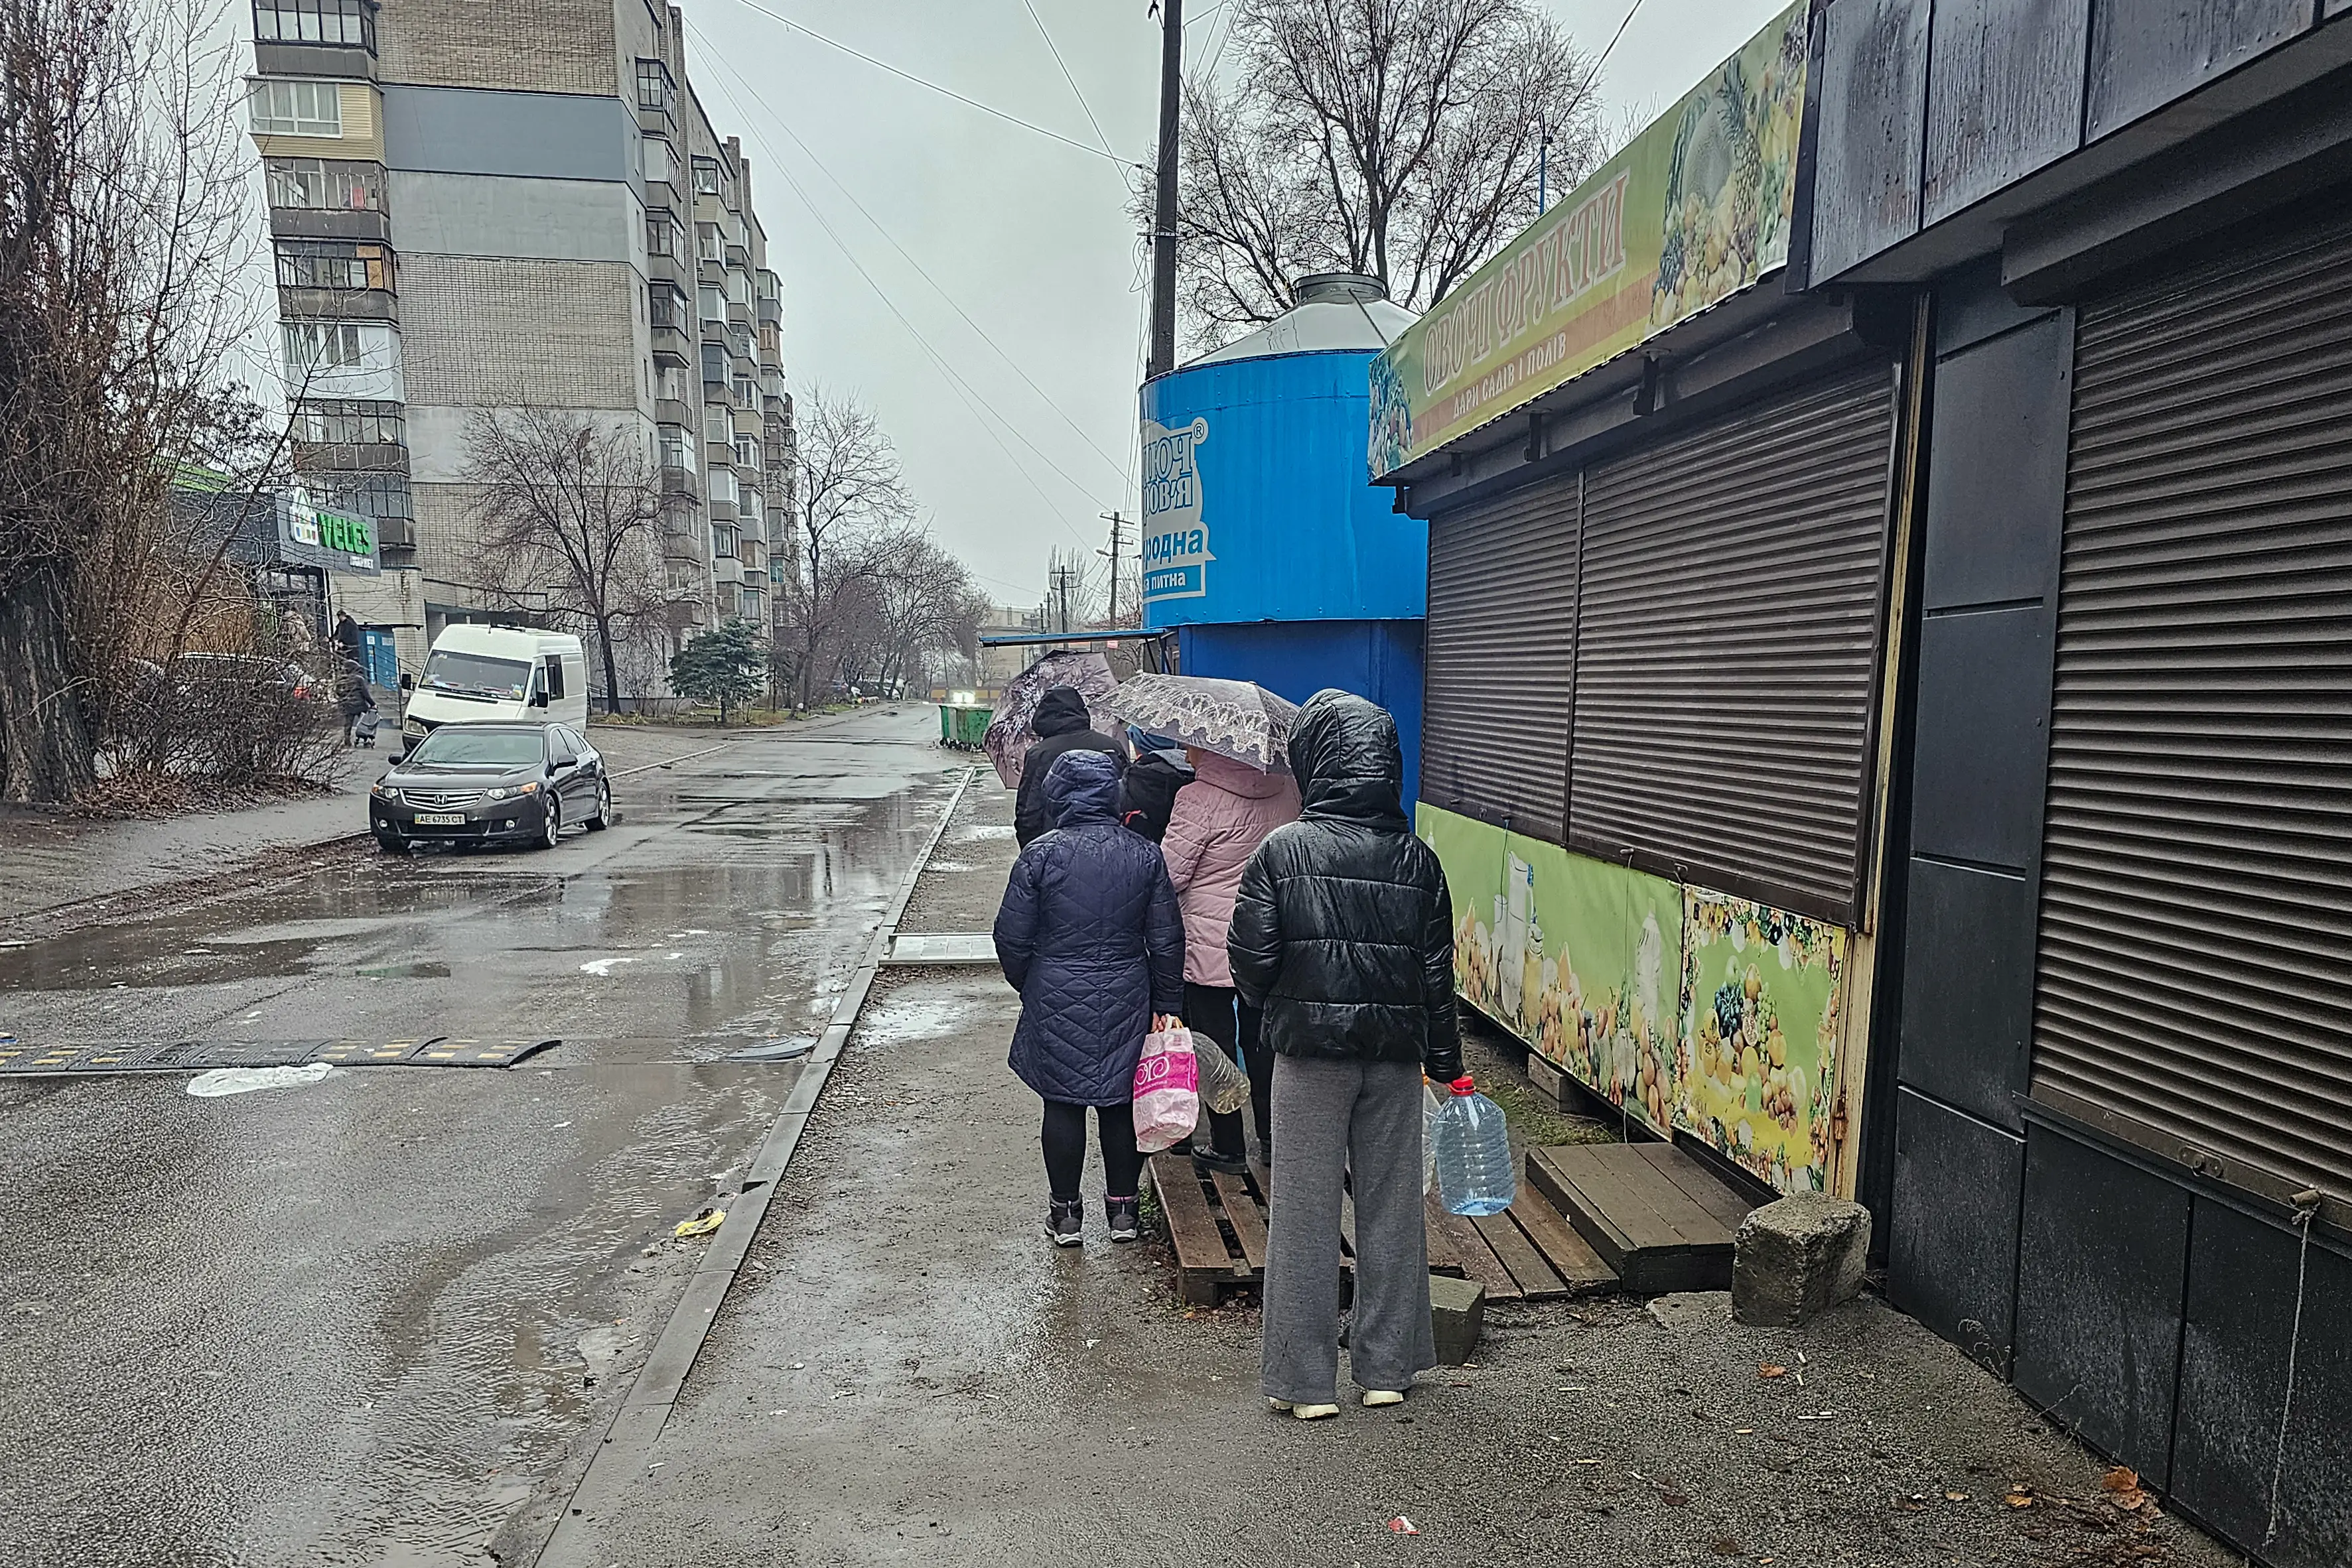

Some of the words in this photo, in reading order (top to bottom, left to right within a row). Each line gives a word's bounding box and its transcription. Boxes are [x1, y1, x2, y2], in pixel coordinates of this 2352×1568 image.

[1424, 274, 1494, 397] ОВОЧІ
[1496, 165, 1630, 348] ФРУКТИ
[1453, 385, 1479, 419] ДАРИ
[1483, 363, 1515, 401] САДІВ
[1527, 332, 1566, 376] ПОЛІВ
[317, 513, 372, 555] VELES
[1151, 572, 1186, 590] питна
